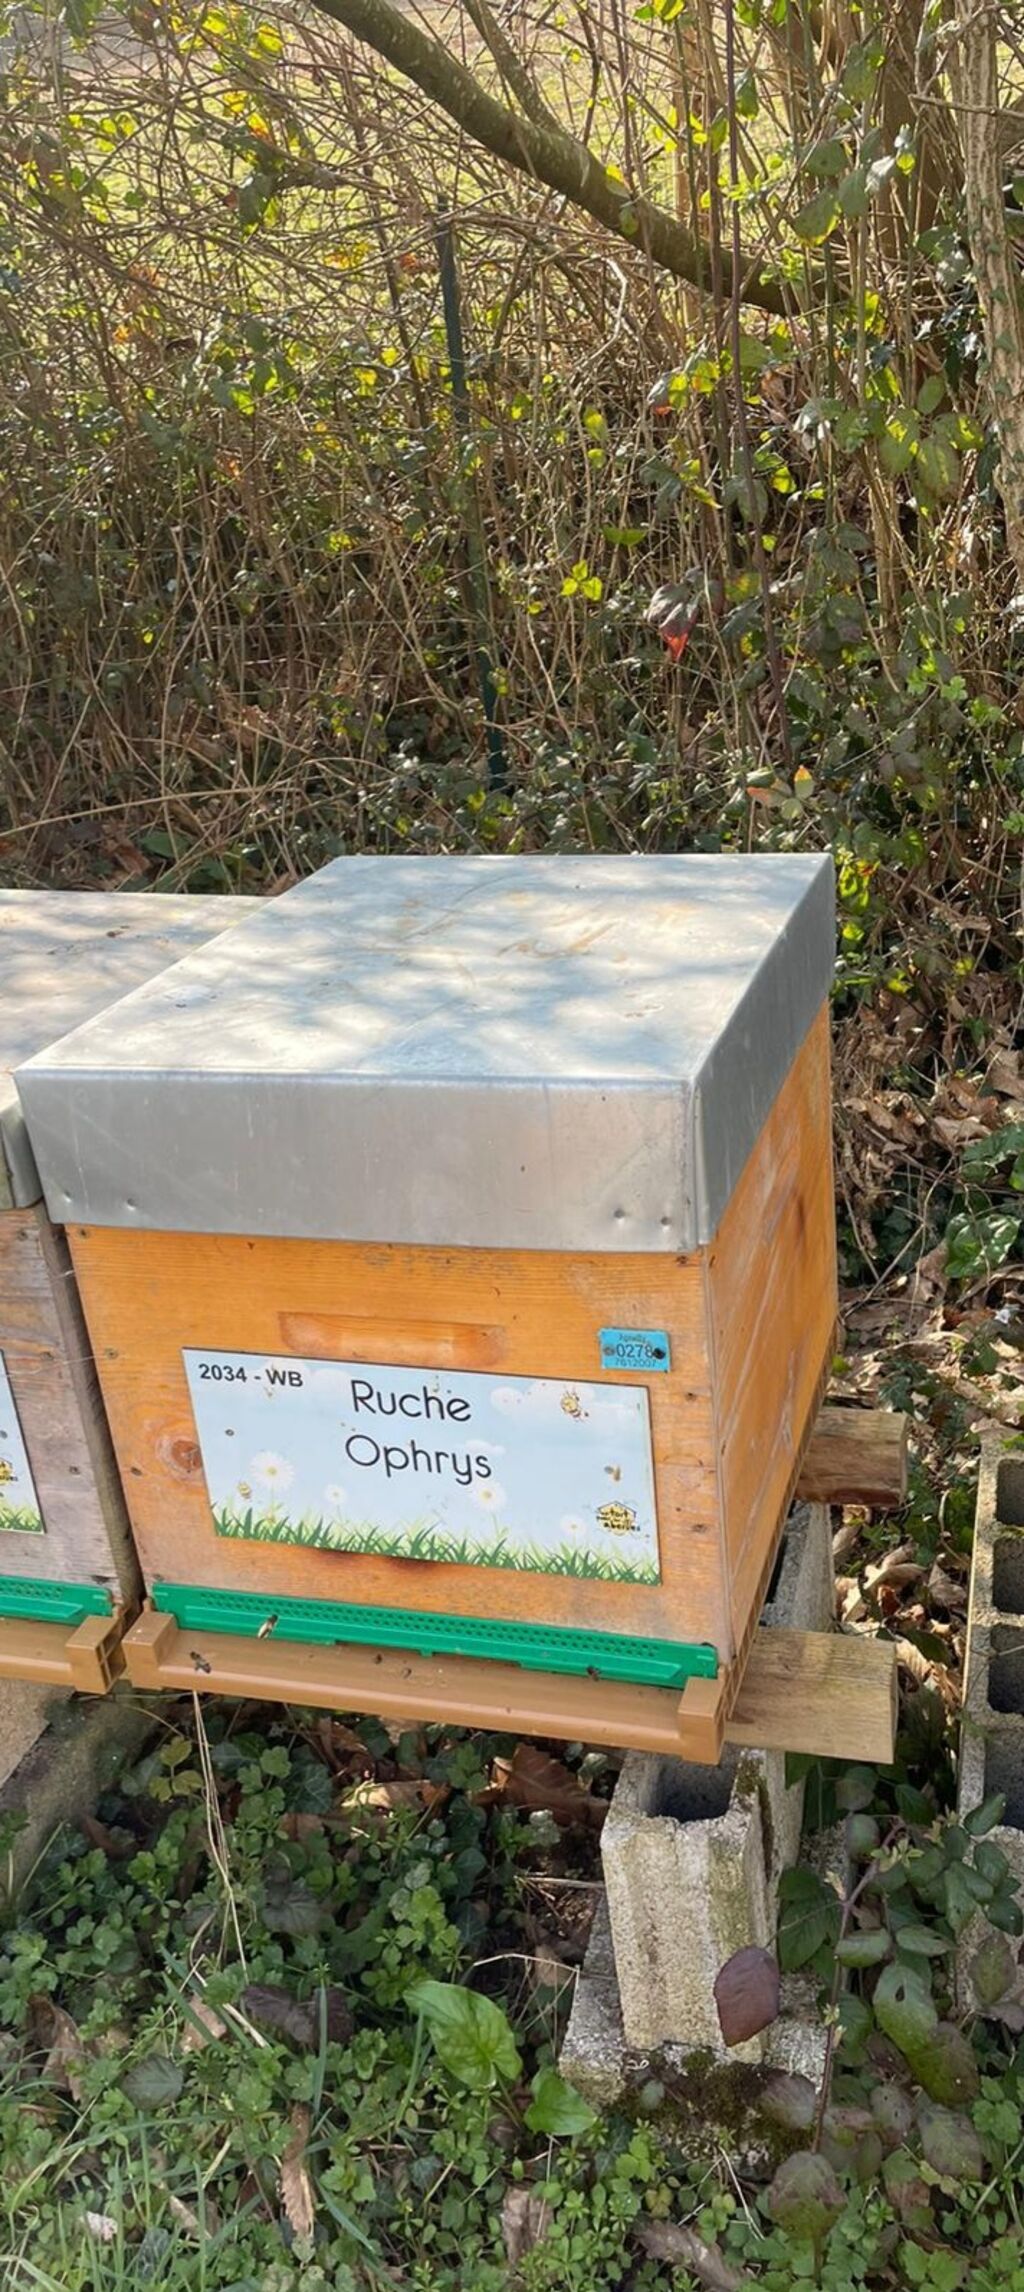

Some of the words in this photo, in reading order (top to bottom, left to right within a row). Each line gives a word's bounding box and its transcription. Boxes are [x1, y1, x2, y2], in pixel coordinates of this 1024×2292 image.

[616, 1343, 653, 1359] 0278
[198, 1363, 248, 1383] 2034
[265, 1368, 304, 1388] WB
[350, 1379, 472, 1422] Ruche
[344, 1433, 493, 1487] Ophrys
